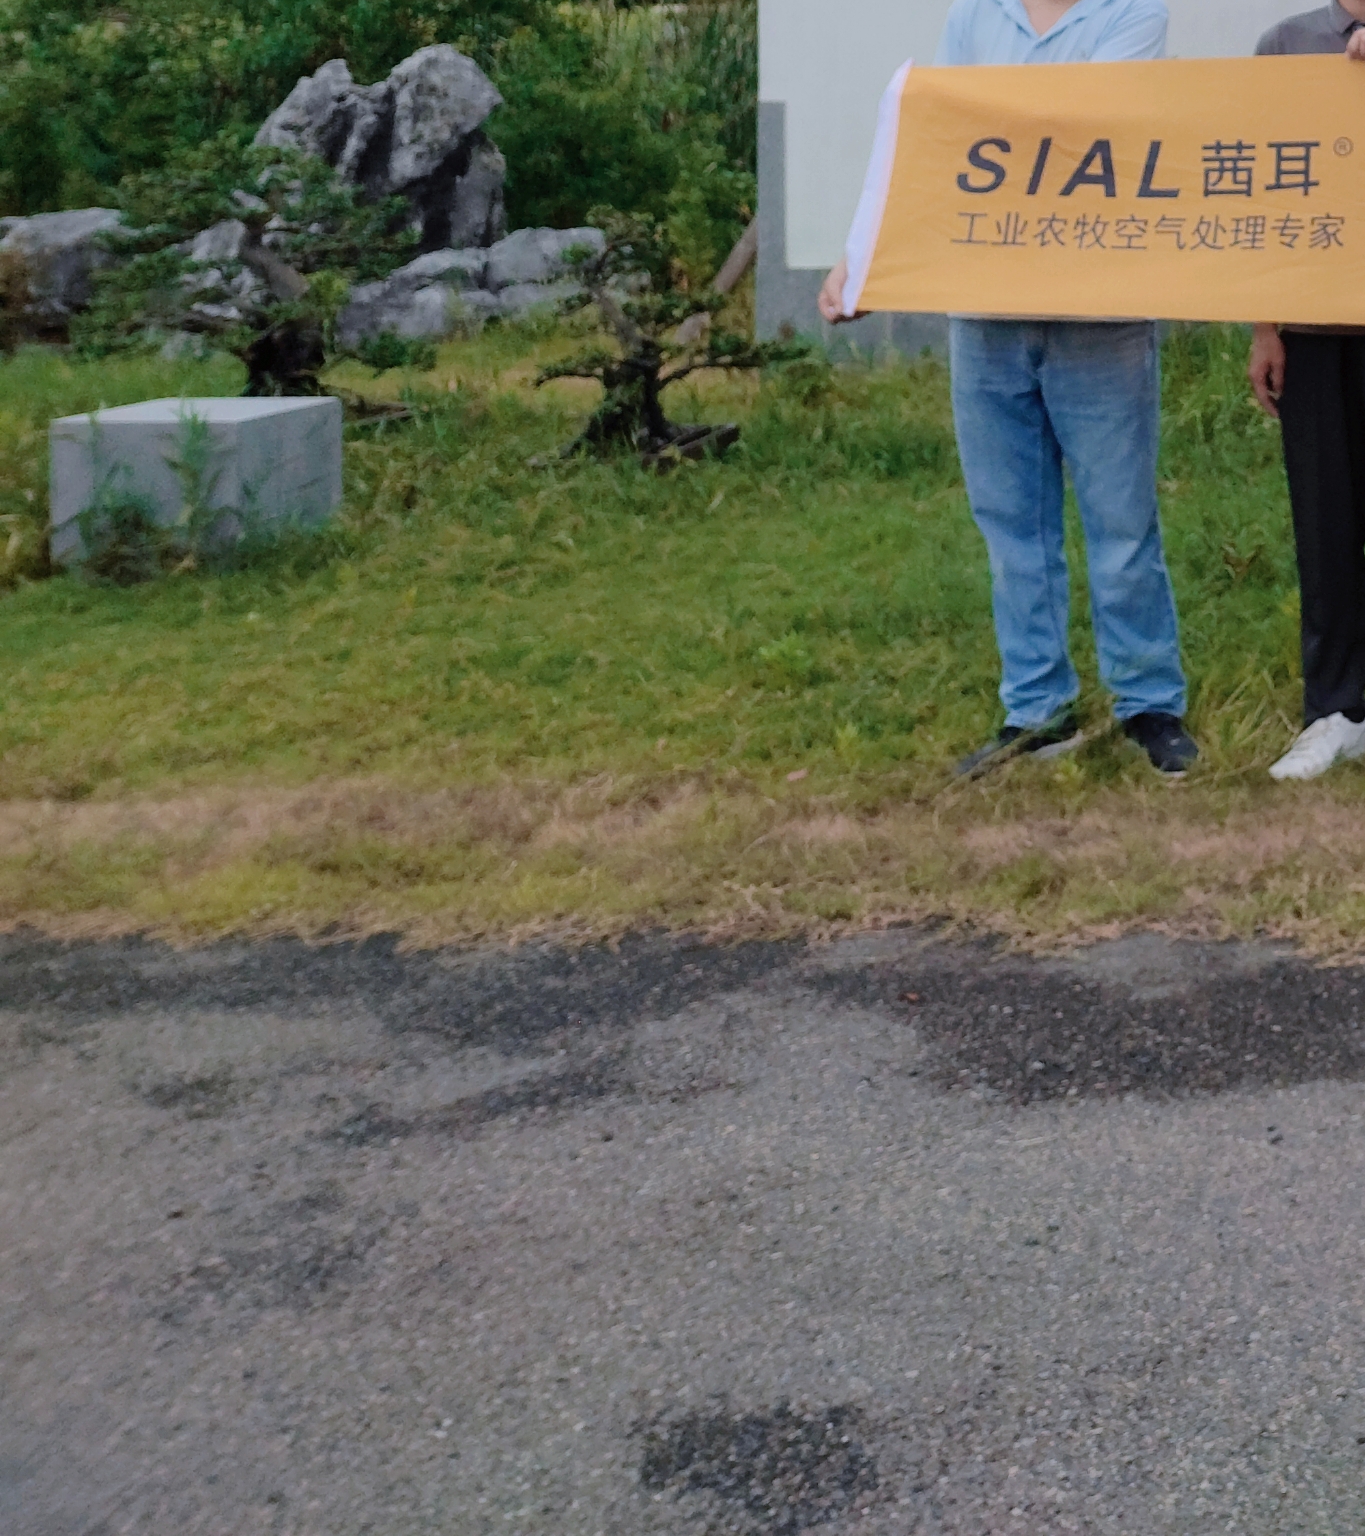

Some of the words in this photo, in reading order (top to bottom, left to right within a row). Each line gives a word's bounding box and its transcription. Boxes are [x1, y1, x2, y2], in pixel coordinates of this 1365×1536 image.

[956, 136, 1181, 199] SIAL
[951, 212, 1346, 251] 工业农牧空气处理专家
